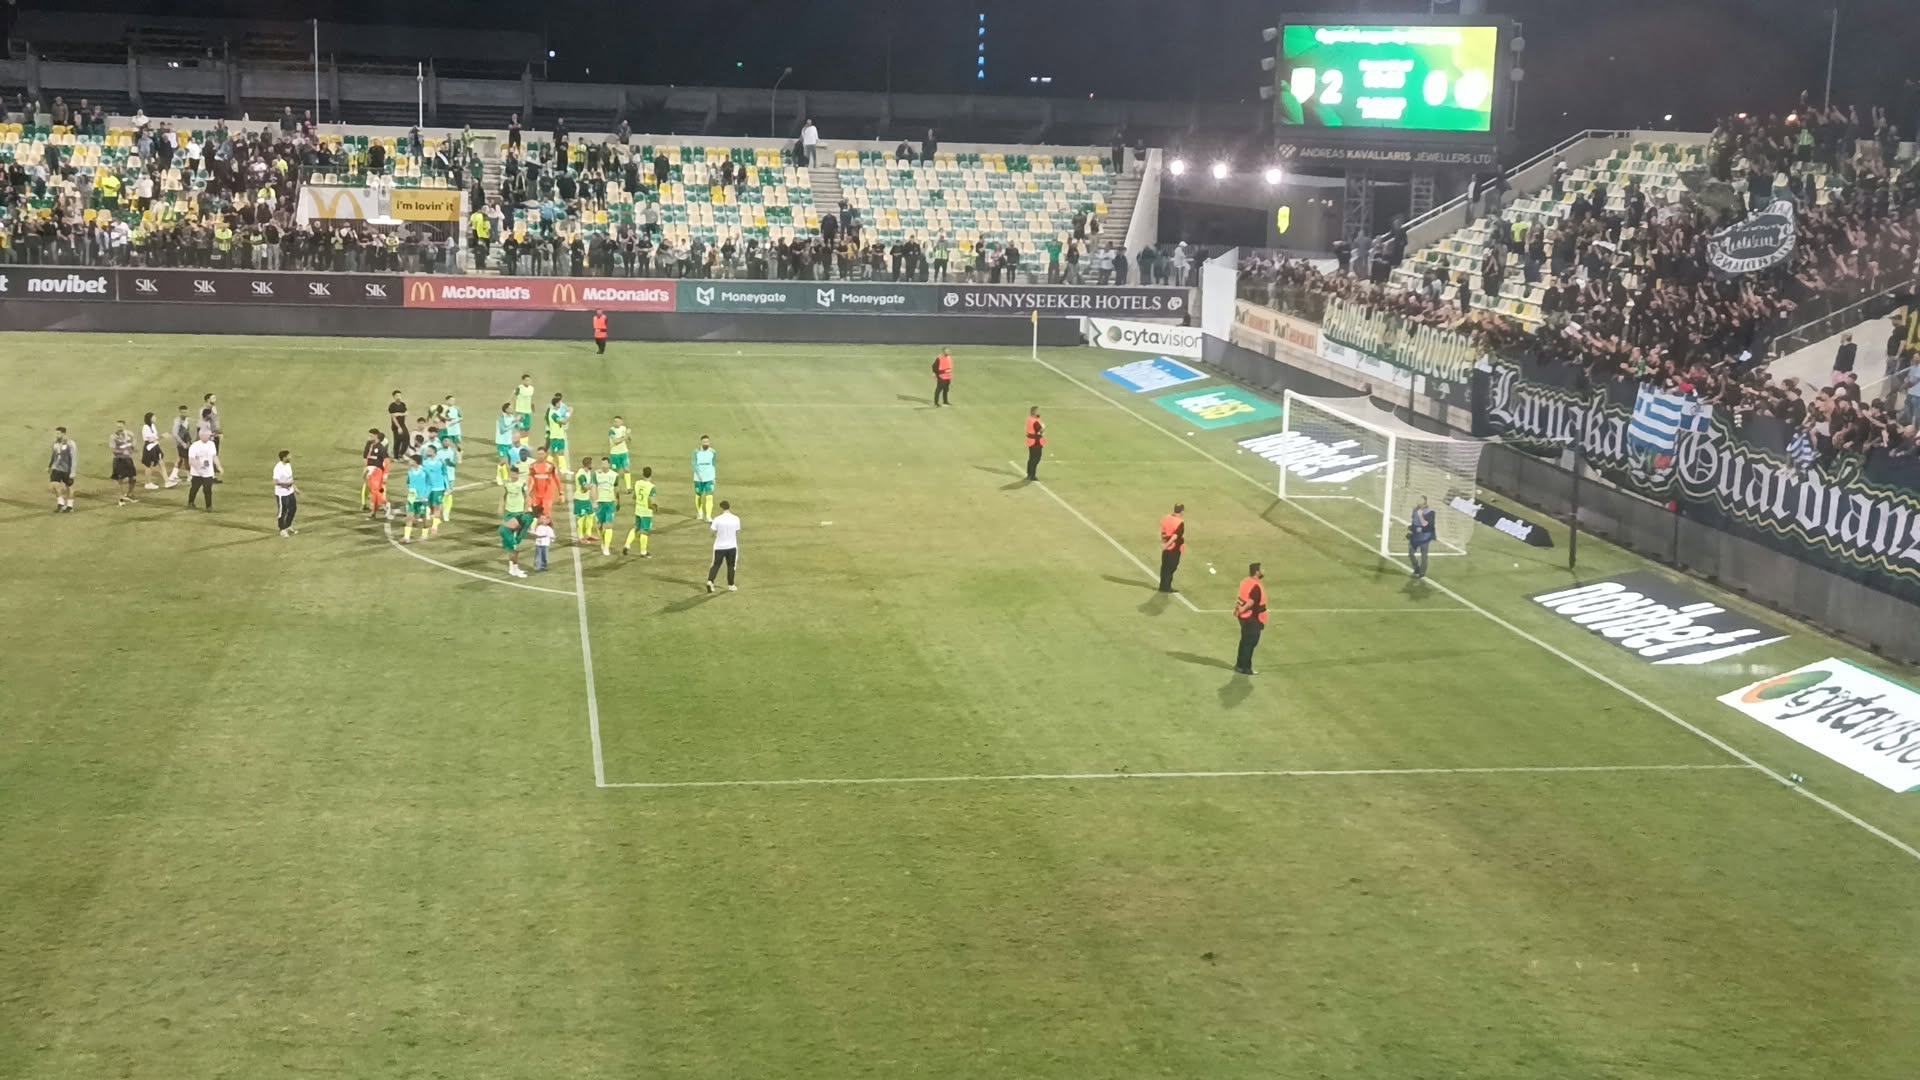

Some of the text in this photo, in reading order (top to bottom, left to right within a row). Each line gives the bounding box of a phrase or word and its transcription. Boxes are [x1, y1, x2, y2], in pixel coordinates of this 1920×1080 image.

[1319, 68, 1344, 105] 2
[1300, 147, 1492, 165] ANDREAS KAVALLARIS JEWELLERS LTD
[396, 200, 454, 212] i'm lovin' it
[27, 274, 108, 294] novibet
[441, 285, 531, 301] McDonald's
[582, 287, 670, 302] McDonald's
[721, 291, 787, 304] Moneygate
[841, 293, 906, 306] Moneygate
[964, 292, 1162, 310] SUNNYSEEKER HOTELS
